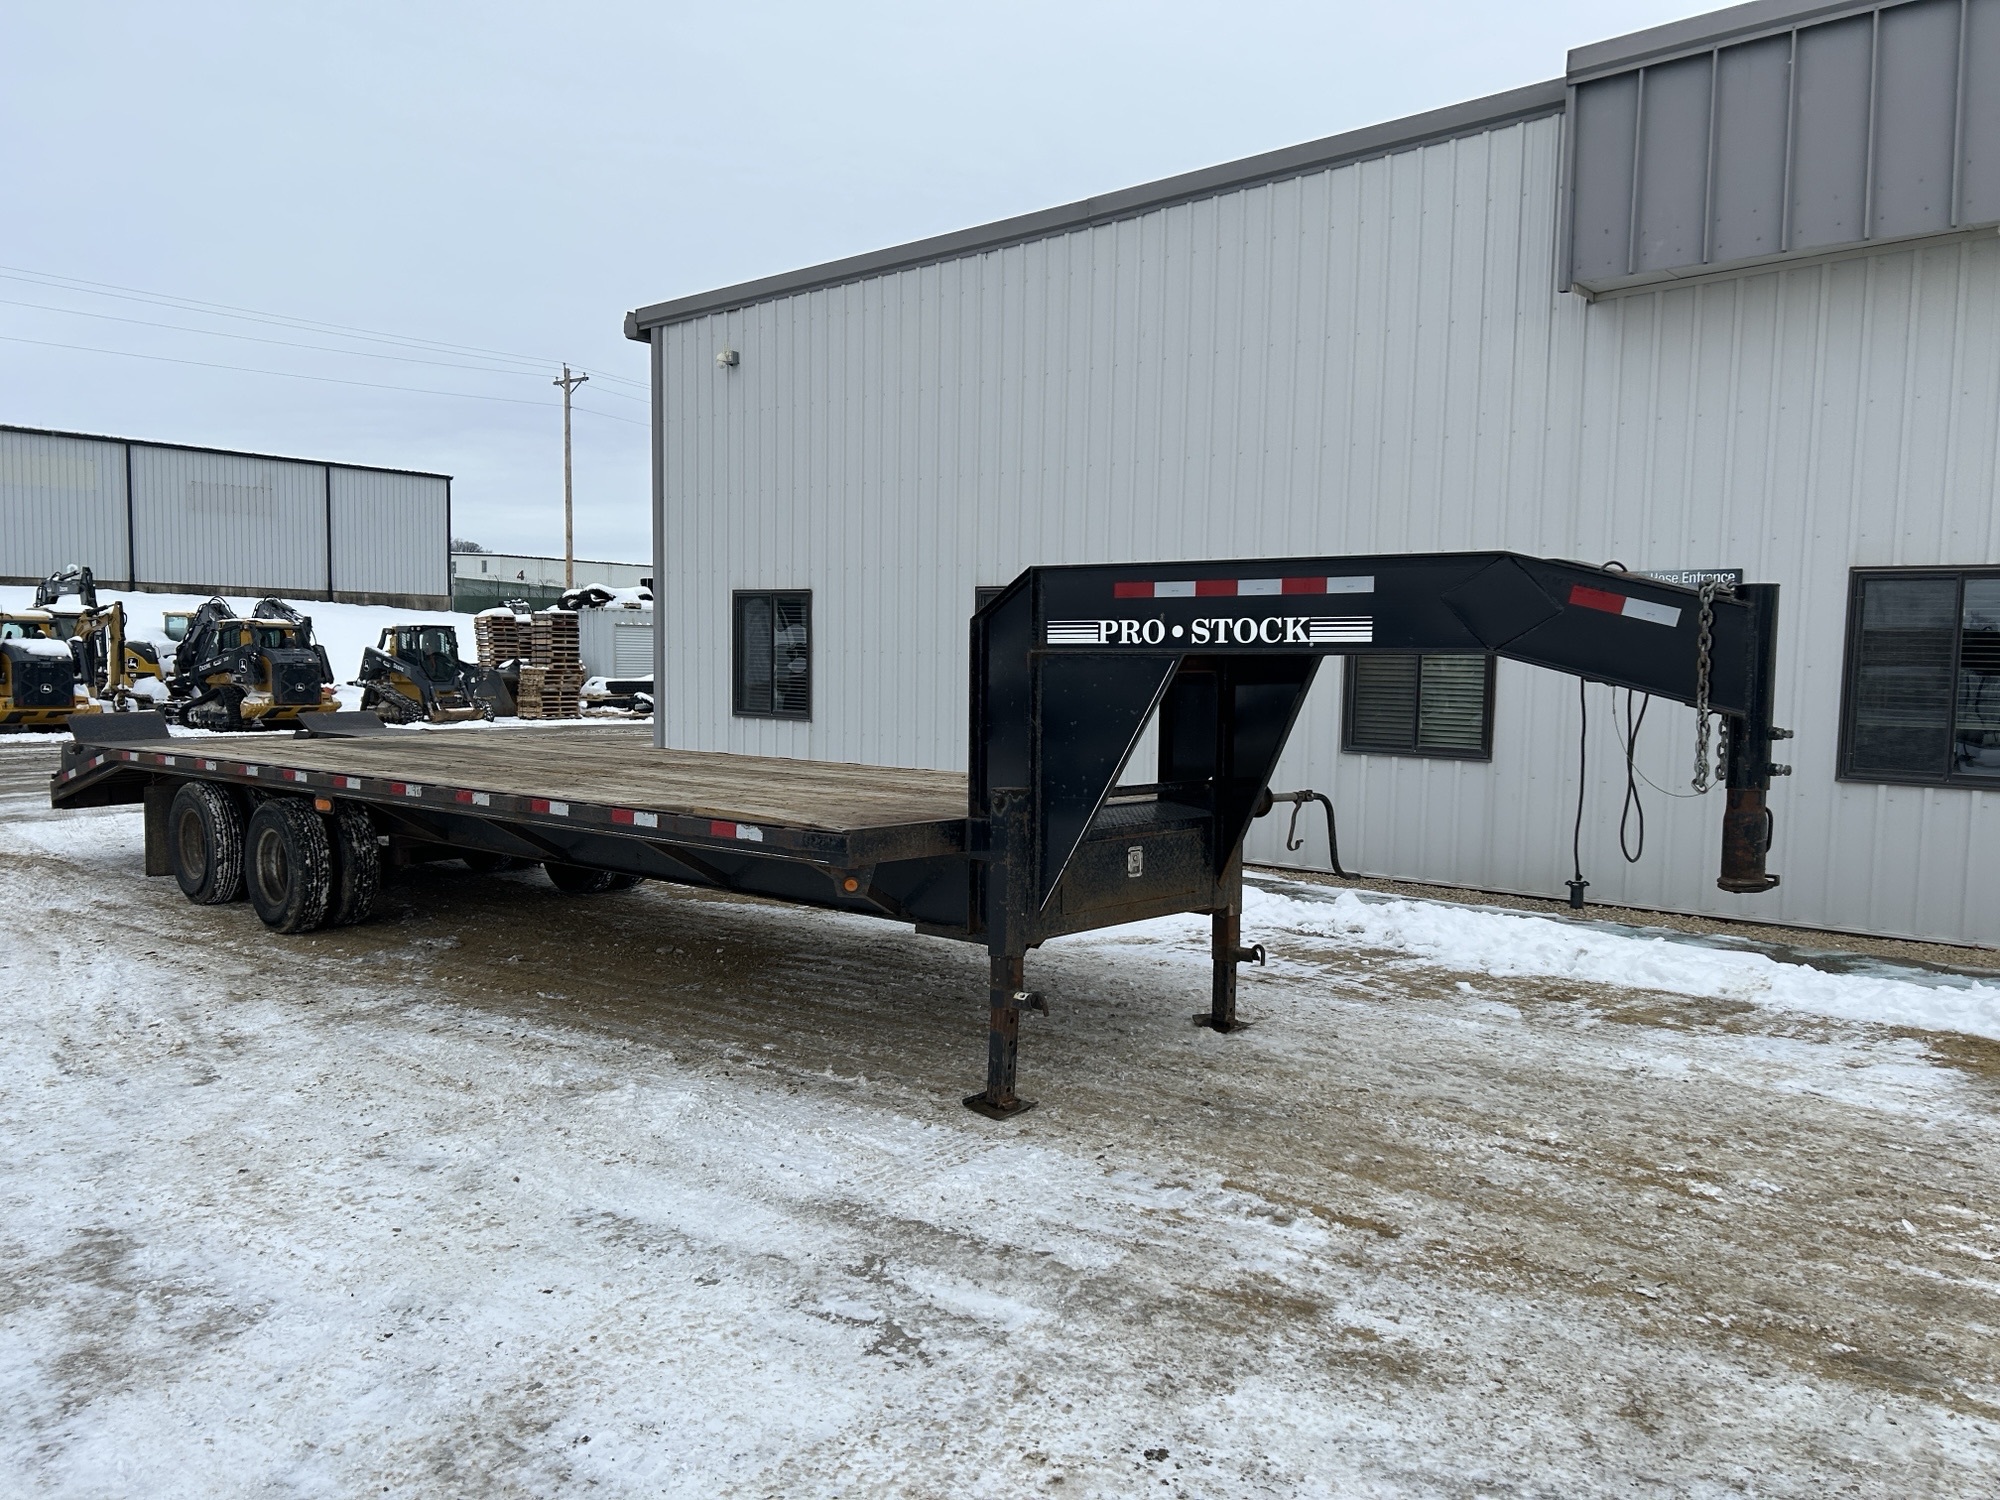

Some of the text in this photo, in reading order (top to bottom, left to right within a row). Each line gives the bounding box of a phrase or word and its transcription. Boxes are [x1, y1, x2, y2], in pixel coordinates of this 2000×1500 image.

[516, 569, 525, 581] 4
[1097, 616, 1311, 645] PRO STOCK
